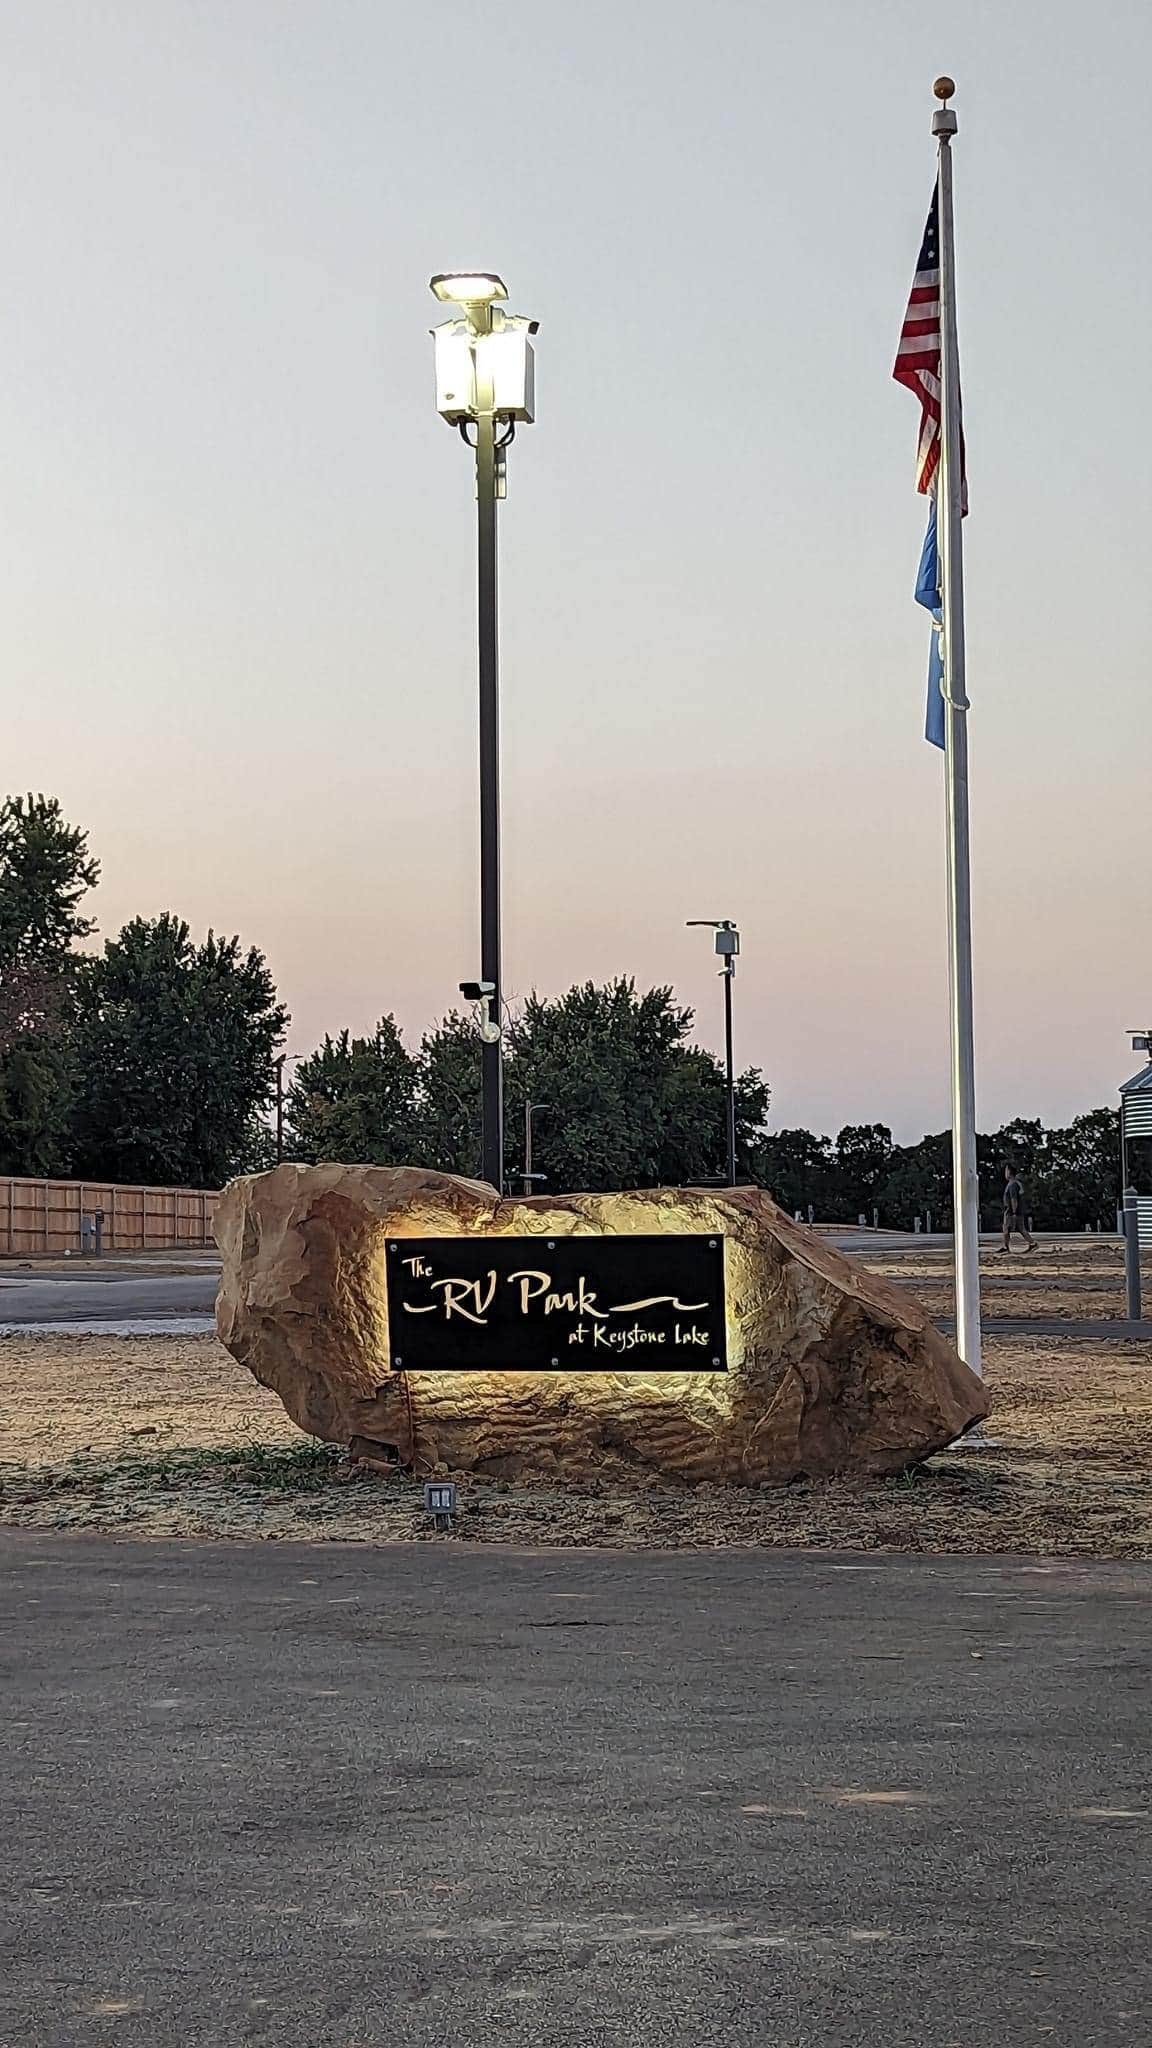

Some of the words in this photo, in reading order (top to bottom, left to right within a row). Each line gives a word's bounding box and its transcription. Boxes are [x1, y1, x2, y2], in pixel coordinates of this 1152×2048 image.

[402, 1256, 433, 1278] The
[431, 1270, 497, 1324] RV
[507, 1271, 610, 1318] Park
[568, 1323, 590, 1344] at
[593, 1323, 666, 1353] Keystone
[674, 1323, 710, 1346] Lake
